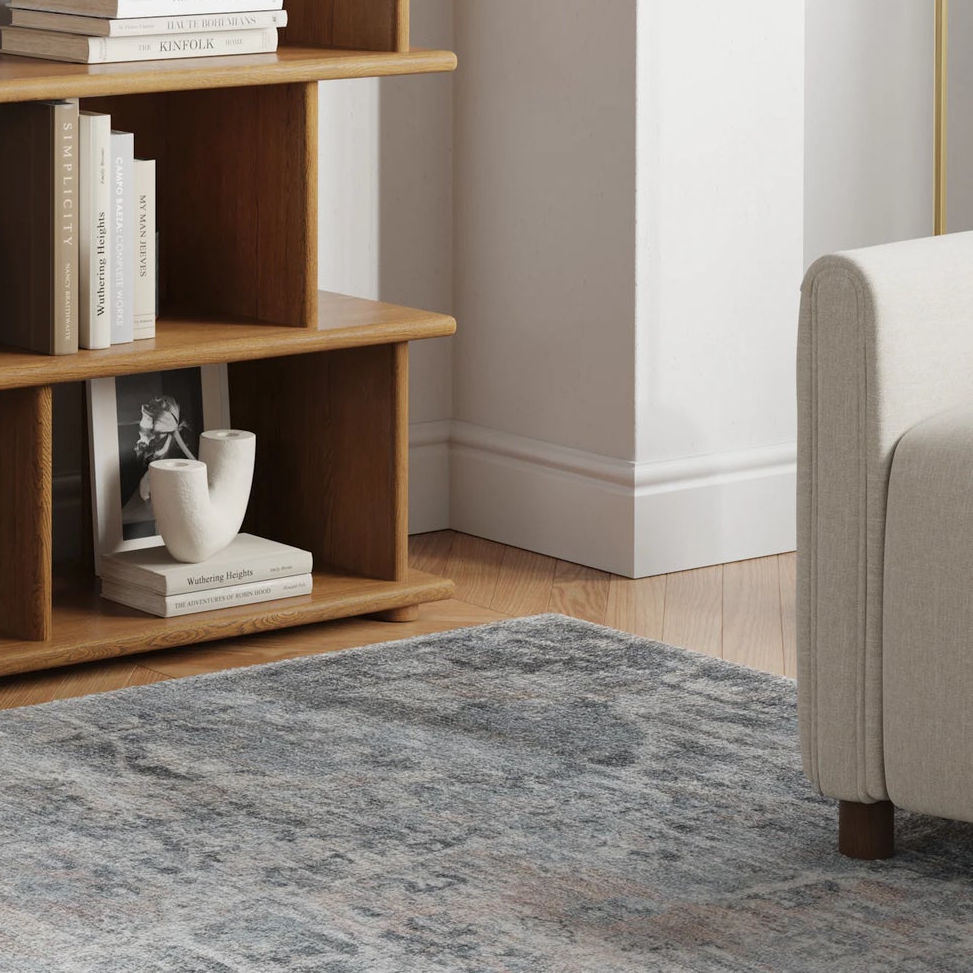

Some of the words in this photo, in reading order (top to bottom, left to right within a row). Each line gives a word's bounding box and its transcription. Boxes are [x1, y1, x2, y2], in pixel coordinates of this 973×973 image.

[167, 18, 198, 30] HAUTE
[201, 16, 257, 29] BOHEMIANS
[160, 38, 215, 52] KINFOLK
[63, 122, 73, 247] SIMPLICITY
[115, 157, 123, 195] CAMPO
[115, 198, 123, 233] BAEZA:
[139, 195, 146, 212] MY
[96, 212, 106, 254] Heights
[115, 235, 123, 288] COMPLETE
[96, 258, 106, 316] Wuthering
[115, 290, 123, 326] WORKS
[187, 573, 224, 586] Wuthering
[226, 570, 254, 582] Heights
[174, 601, 186, 610] THE
[188, 596, 226, 607] ADVENTURES
[235, 590, 253, 600] ROBIN
[254, 588, 272, 596] HOOD
